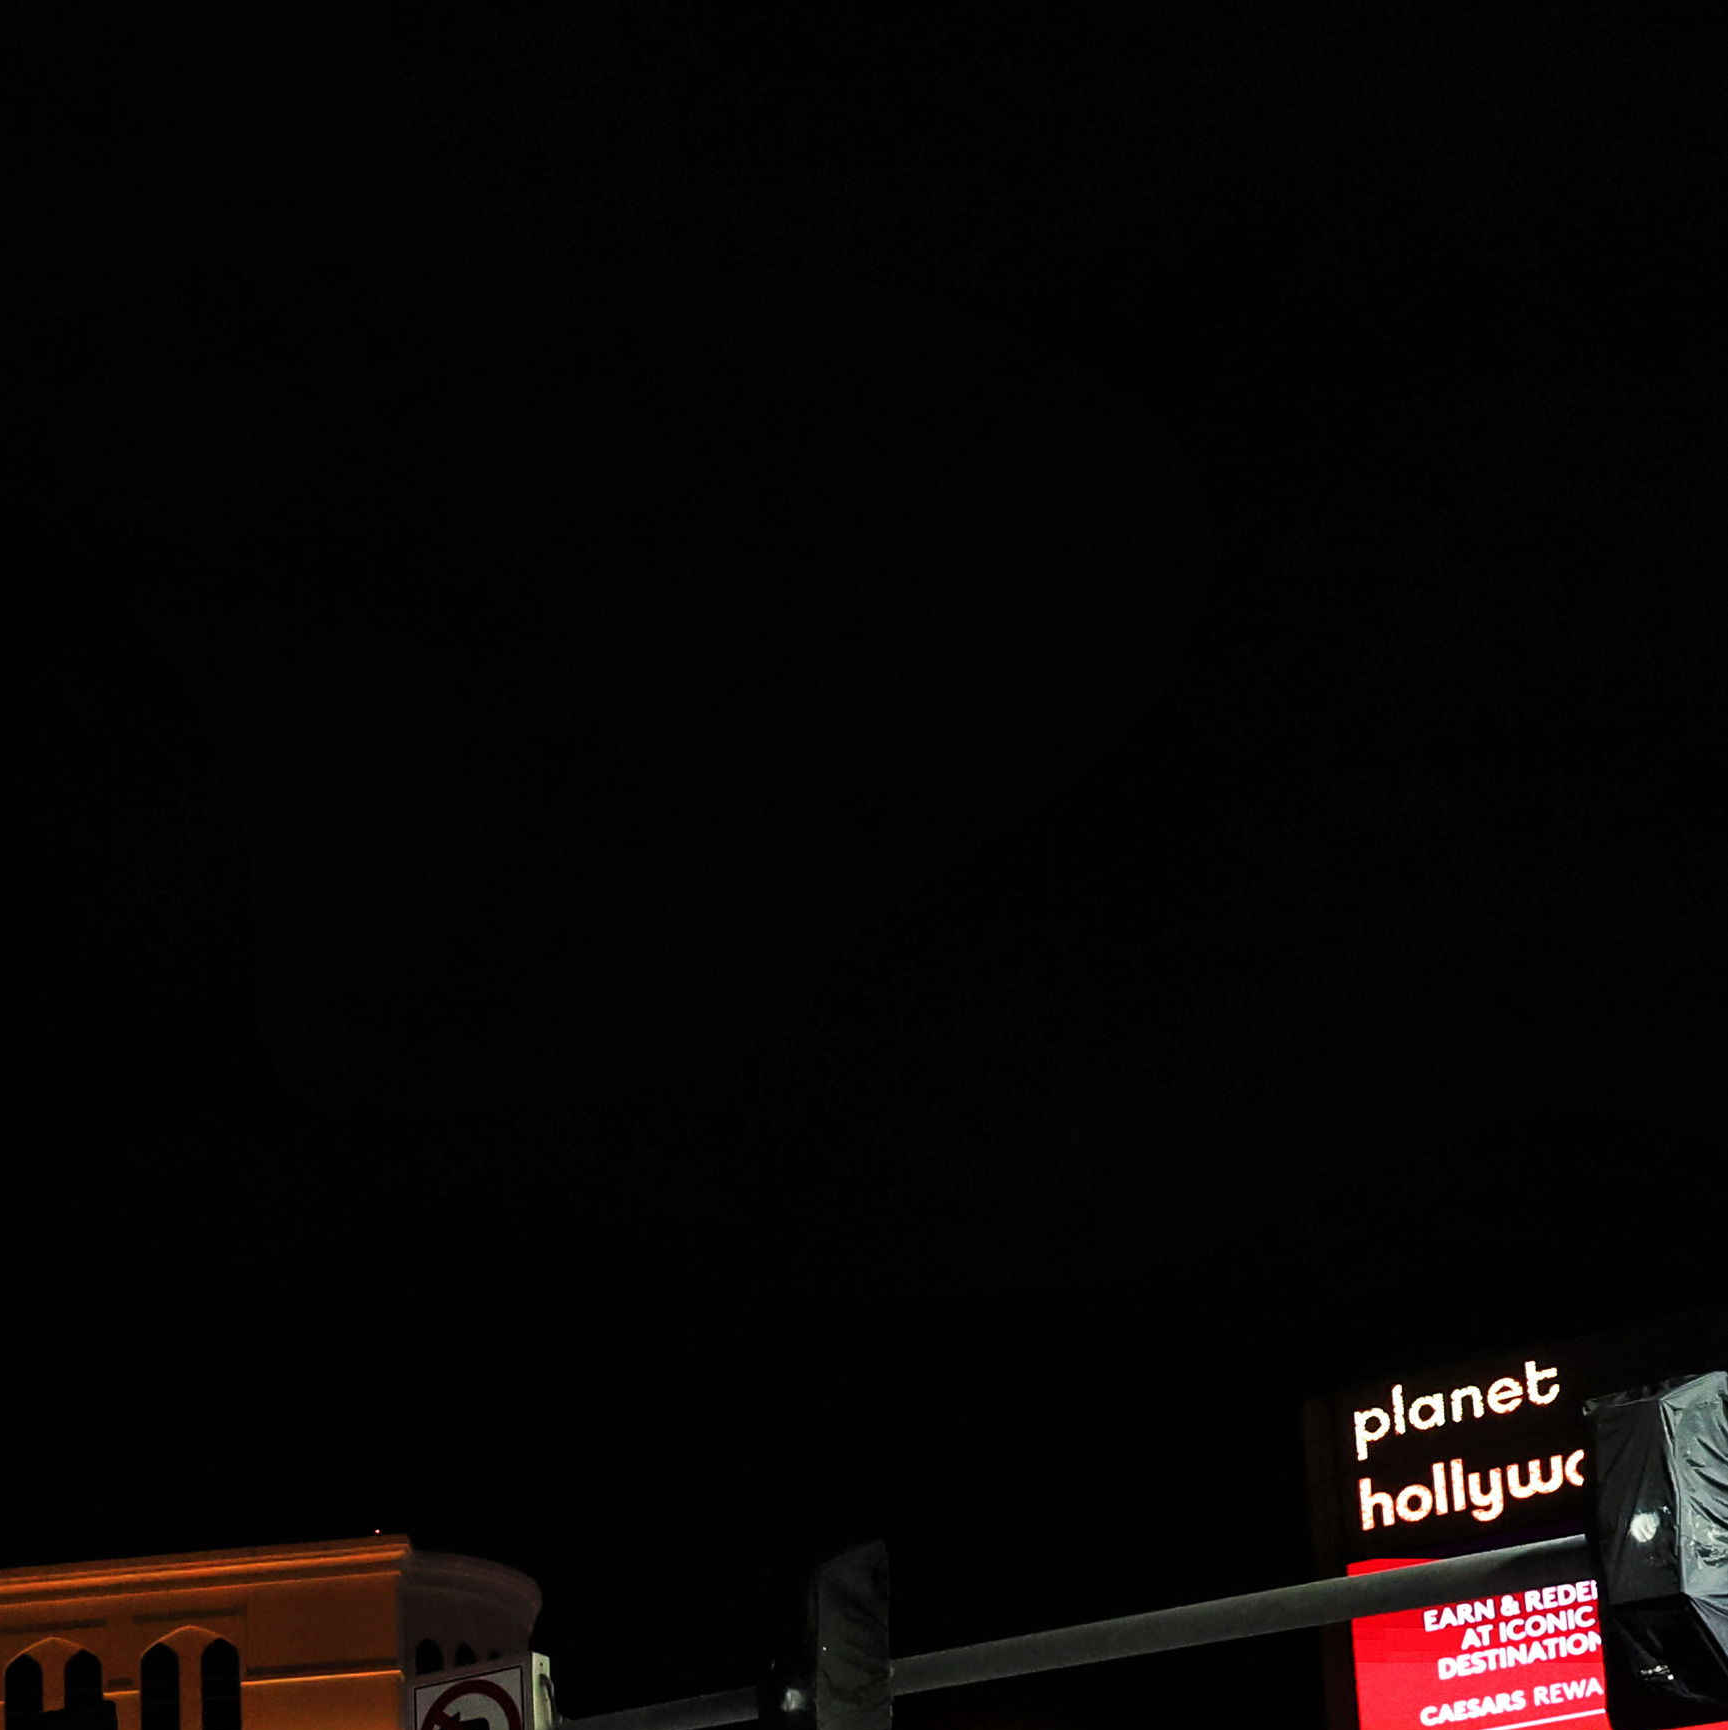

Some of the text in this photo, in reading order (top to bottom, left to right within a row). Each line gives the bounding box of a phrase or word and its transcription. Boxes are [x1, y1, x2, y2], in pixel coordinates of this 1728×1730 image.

[1354, 1360, 1560, 1461] planet
[1423, 1597, 1495, 1632] EARN
[1500, 1593, 1520, 1617] &
[1460, 1604, 1597, 1650] AT ICONIC
[1420, 1689, 1527, 1727] CAESARS
